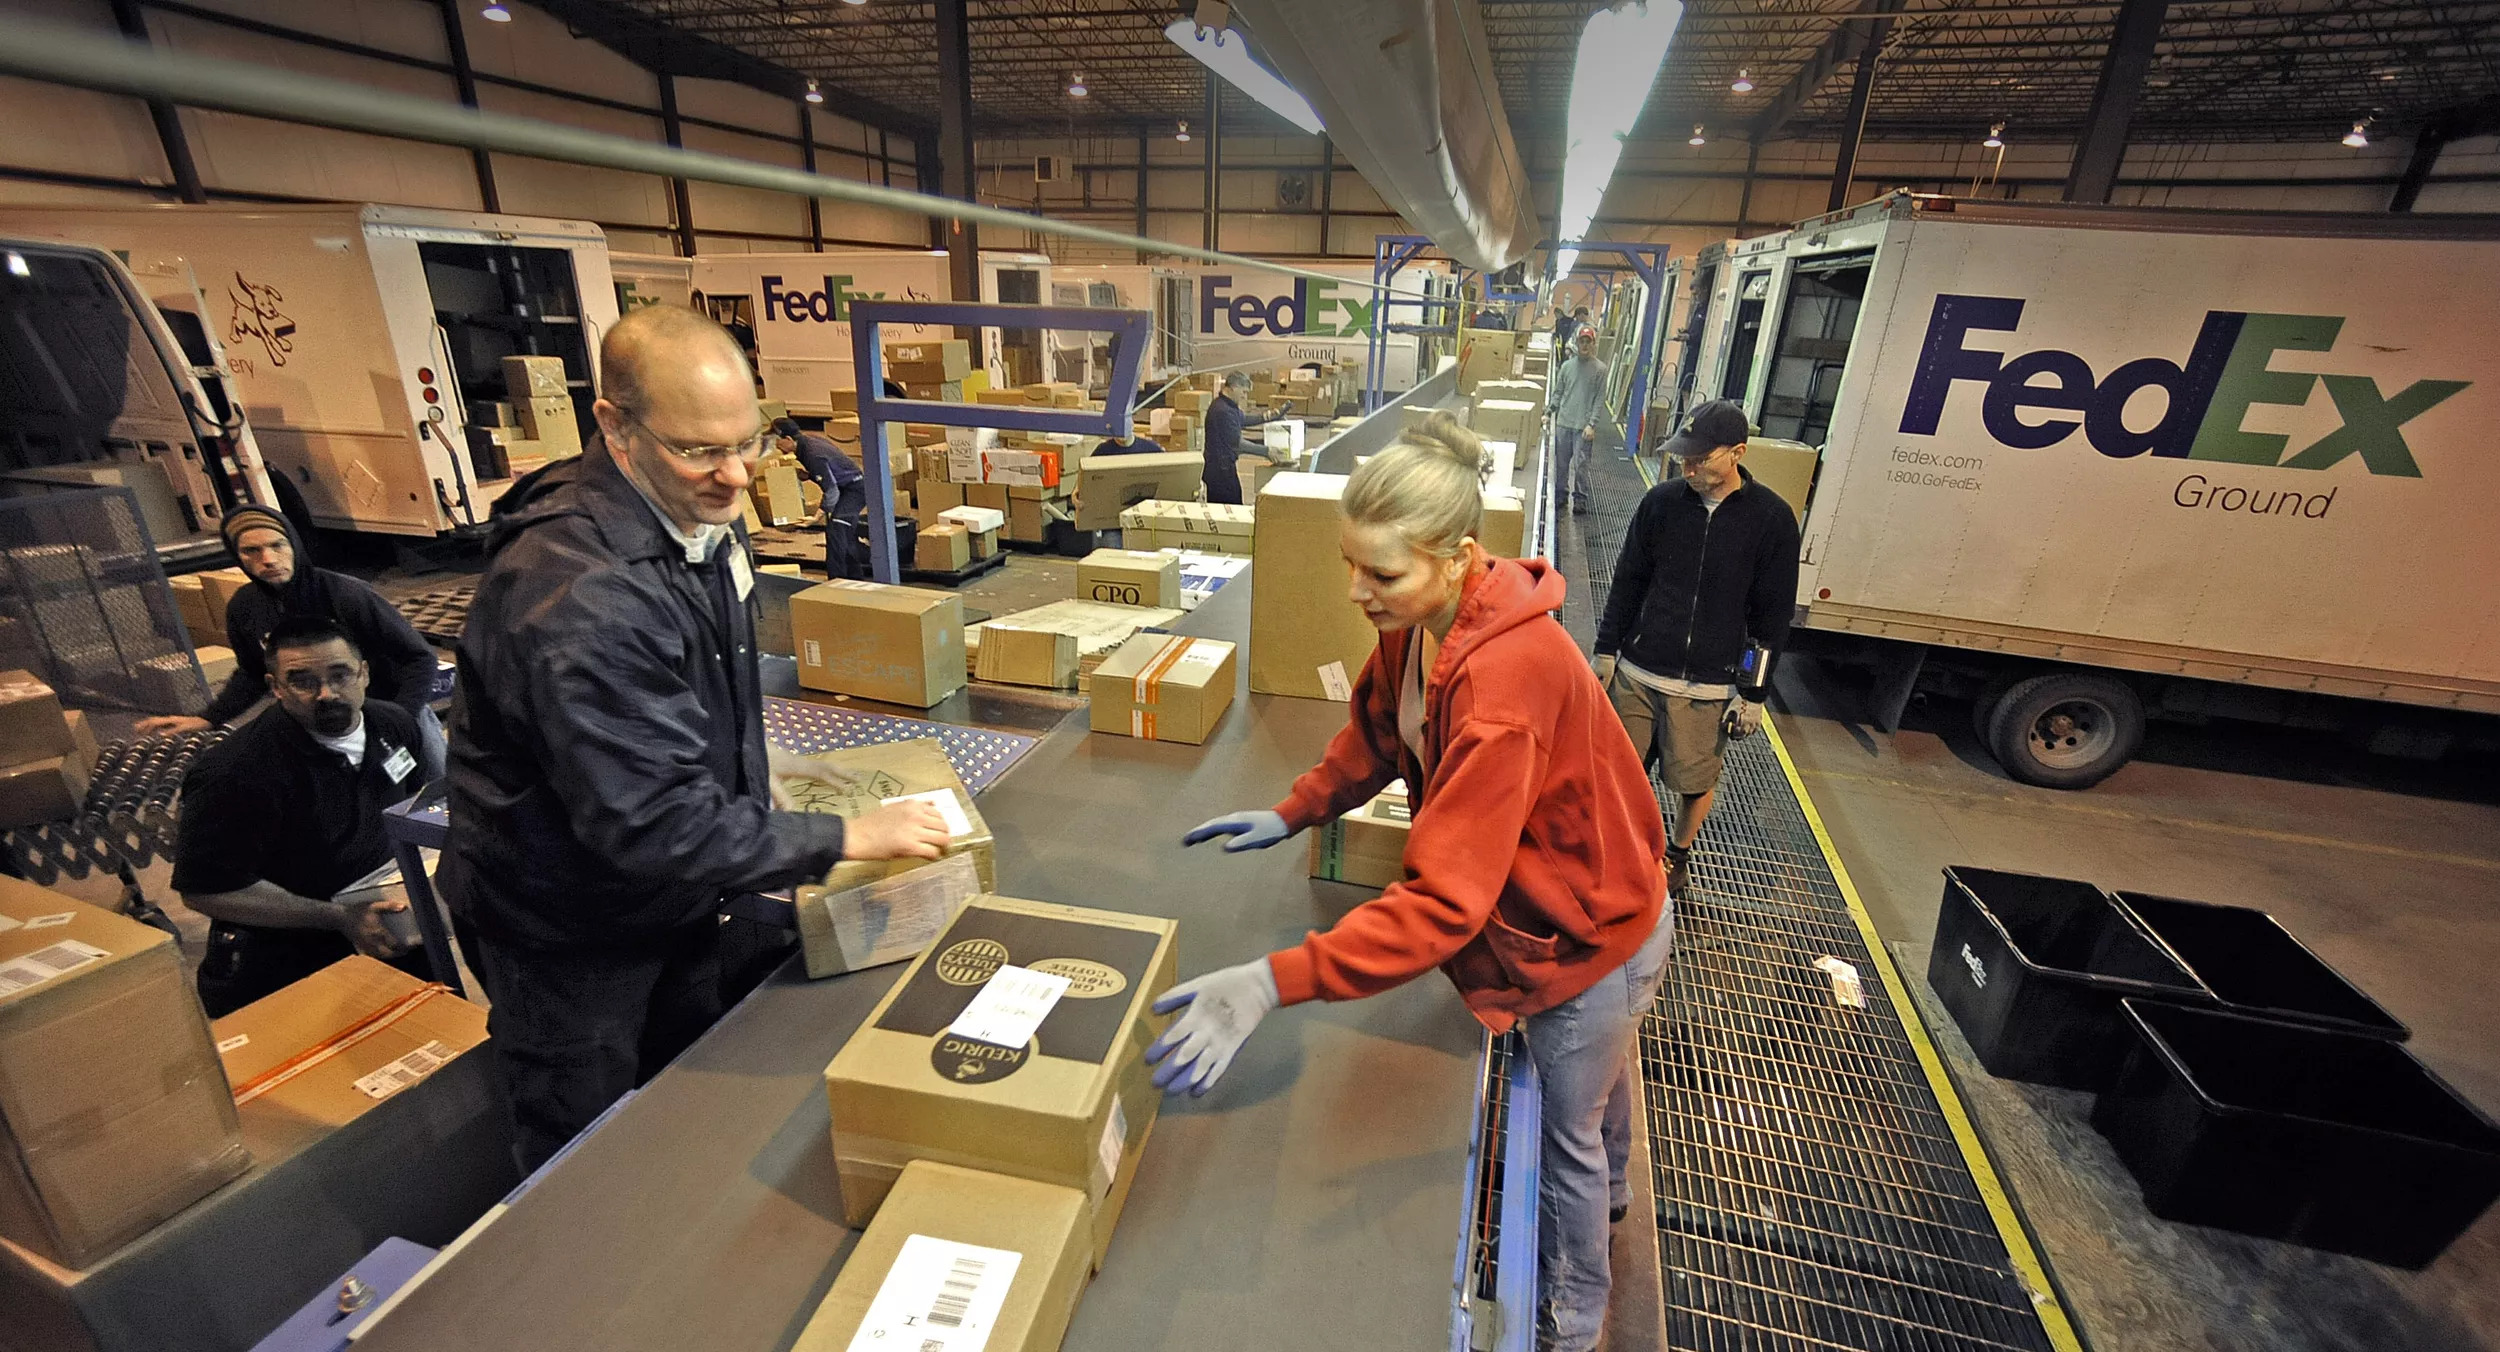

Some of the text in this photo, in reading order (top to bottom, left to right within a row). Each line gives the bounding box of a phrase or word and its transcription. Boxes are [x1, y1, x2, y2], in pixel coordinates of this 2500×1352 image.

[761, 275, 885, 323] FedE
[1200, 275, 1384, 338] FedEx
[1288, 343, 1336, 362] Ground
[1898, 293, 2474, 479] FedEx
[1892, 446, 1983, 470] fedex.com
[1887, 470, 1982, 490] 1.800.GoFedEx
[2174, 474, 2338, 519] Ground
[1092, 584, 1140, 605] CPO
[1050, 963, 1107, 978] COFFEE
[944, 1039, 1022, 1063] KEURIG
